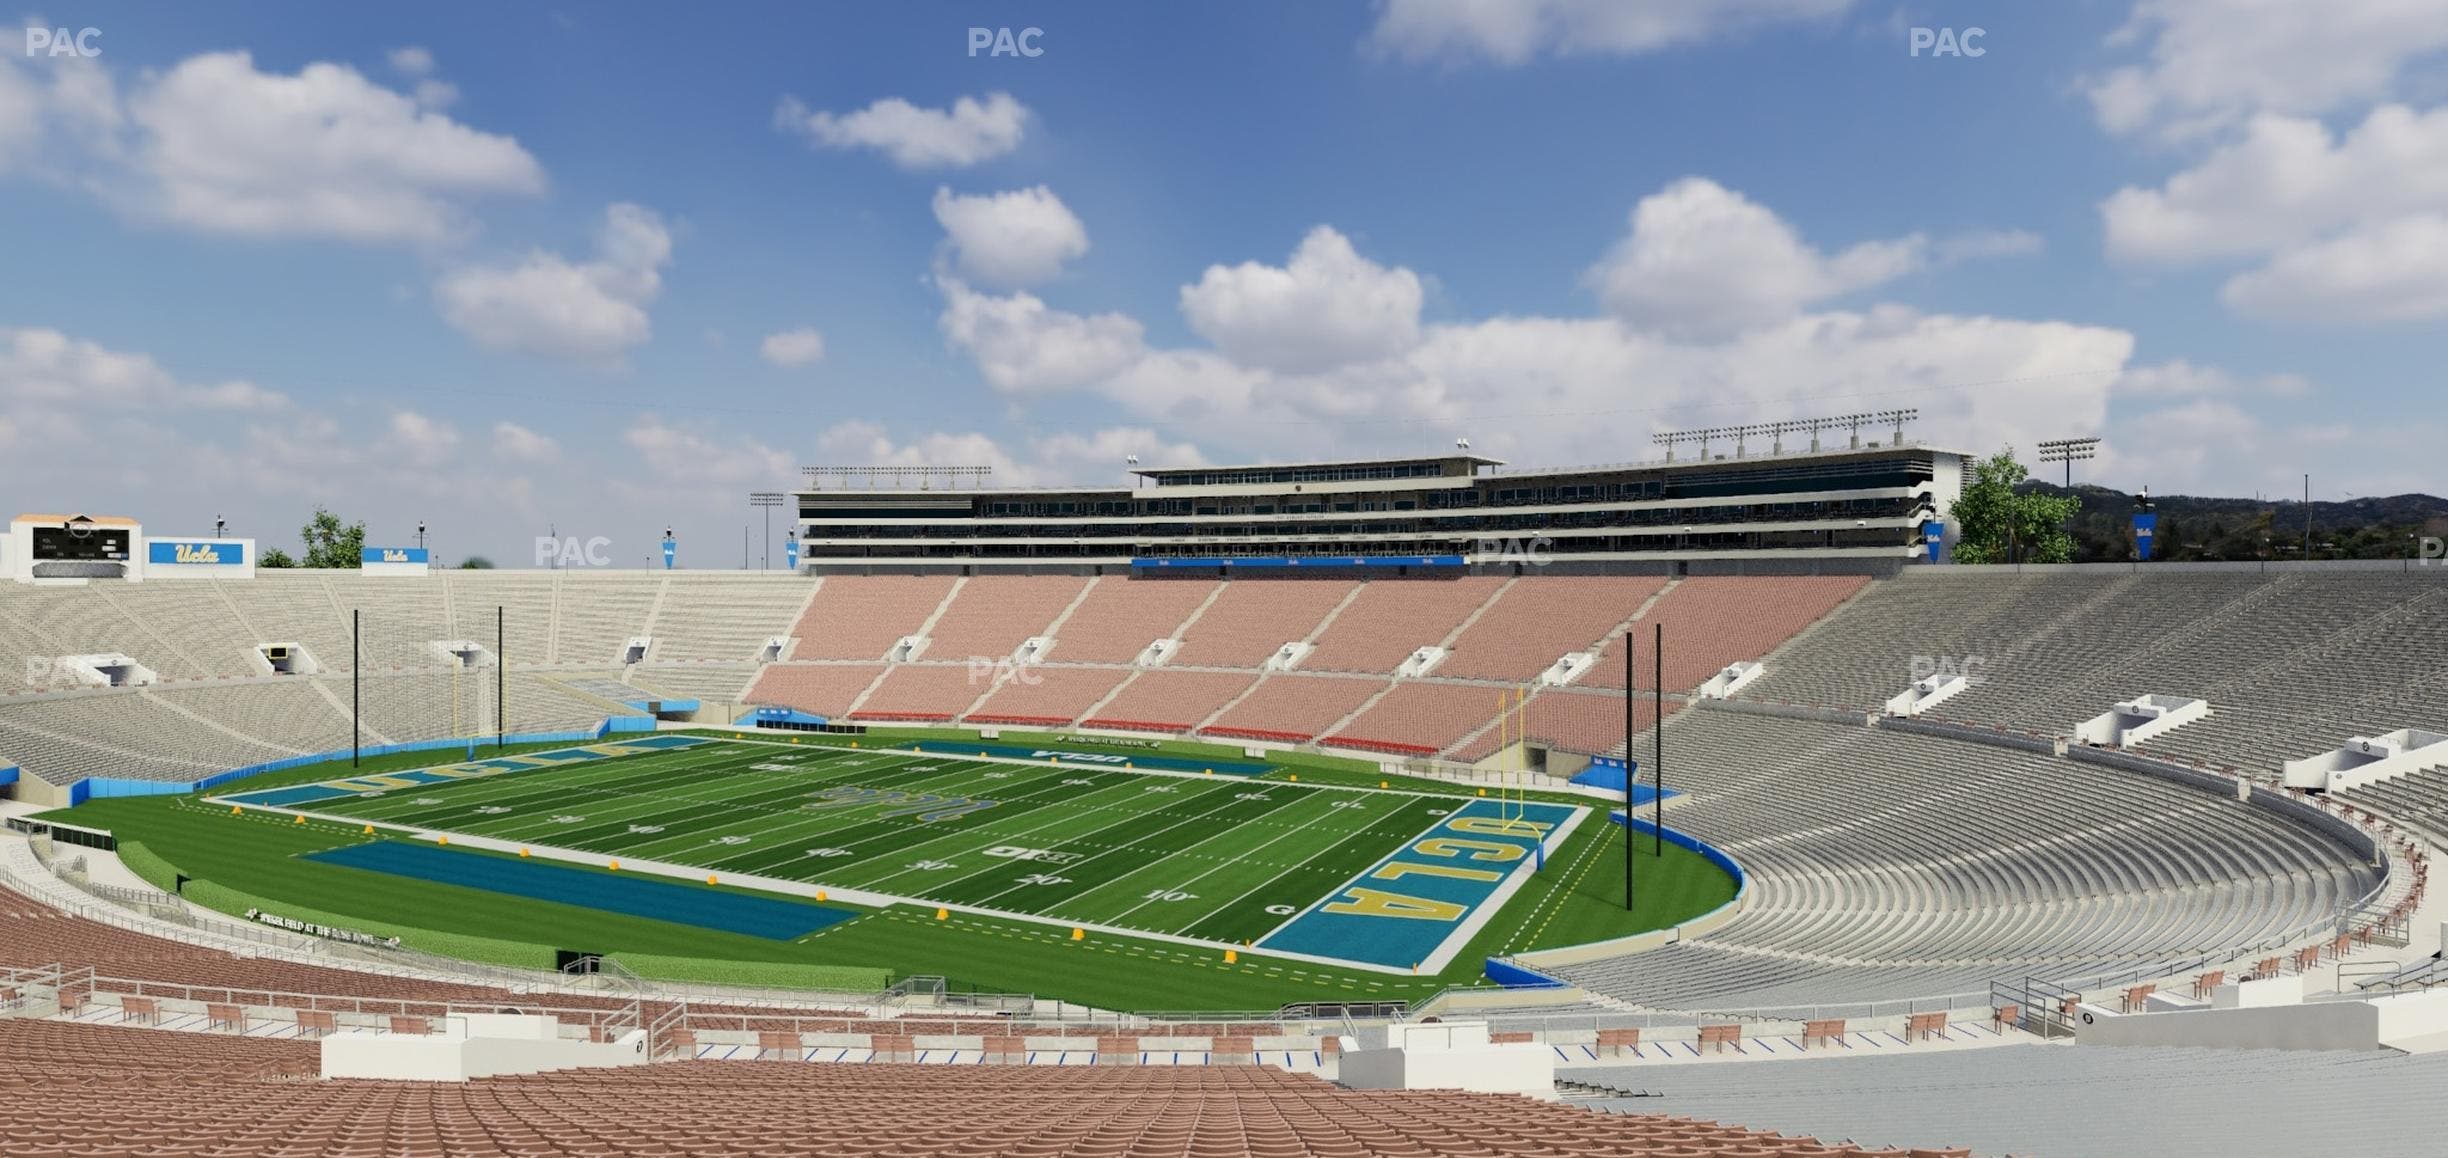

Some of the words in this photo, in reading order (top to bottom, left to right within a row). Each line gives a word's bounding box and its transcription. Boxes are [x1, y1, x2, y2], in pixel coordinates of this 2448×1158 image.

[1319, 816, 1555, 922] UCLA
[1014, 874, 1062, 885] 20
[1142, 890, 1189, 901] 10
